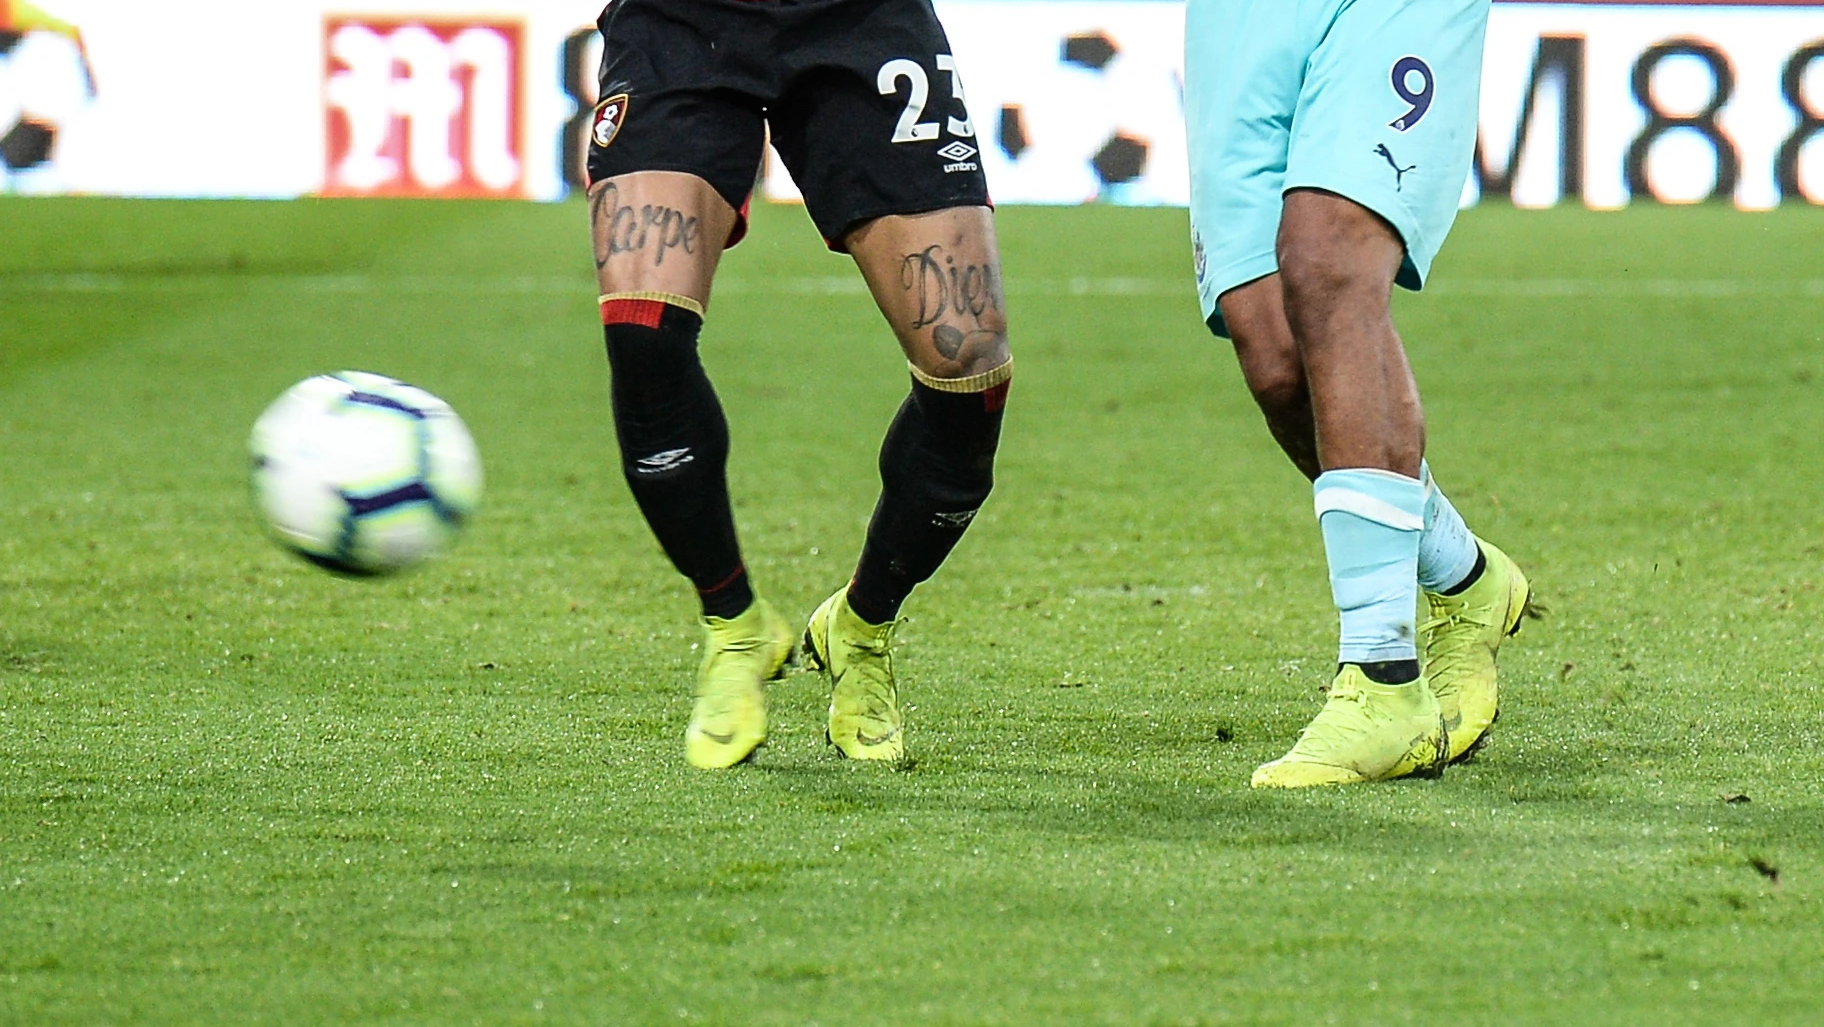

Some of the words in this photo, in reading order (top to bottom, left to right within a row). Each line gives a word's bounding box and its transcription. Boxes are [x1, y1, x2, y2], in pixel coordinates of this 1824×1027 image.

[877, 53, 975, 144] 23
[1384, 53, 1437, 135] 9
[943, 161, 978, 174] umbro
[588, 181, 701, 271] Carpe
